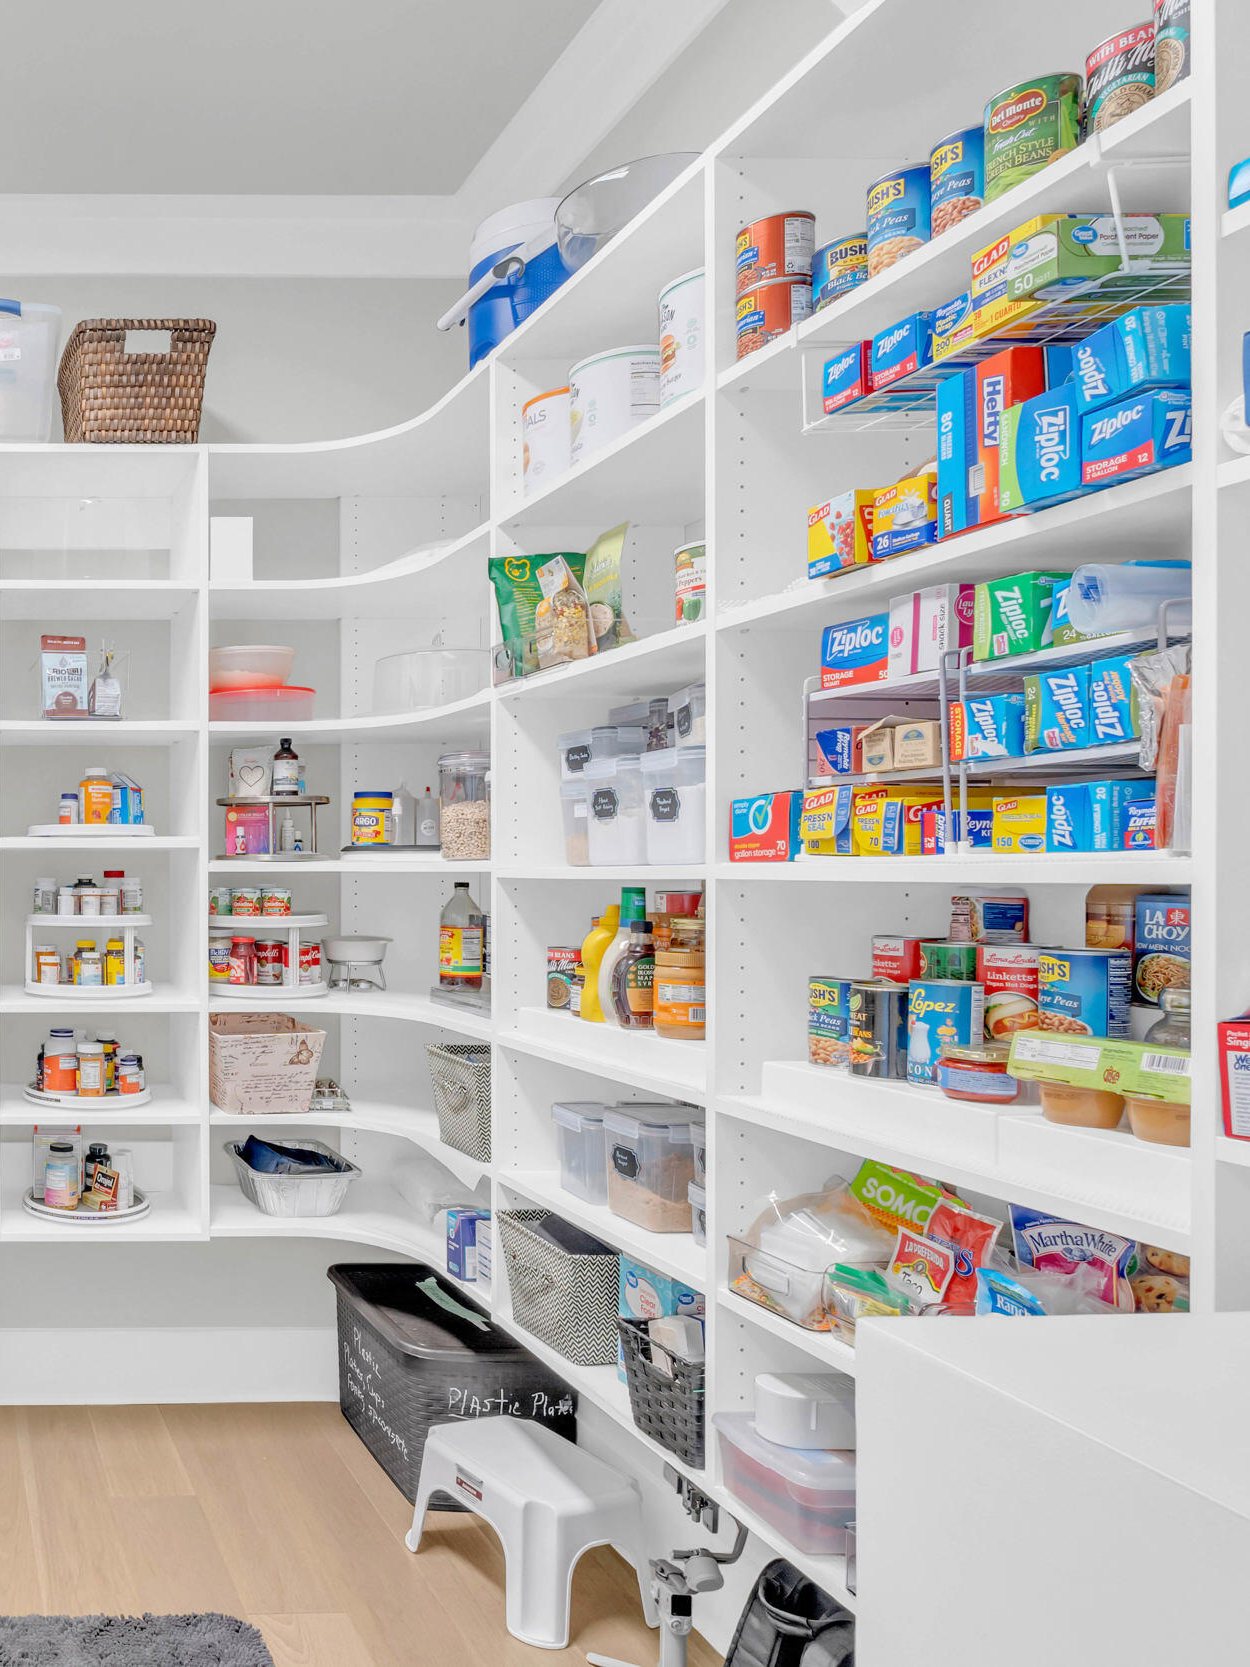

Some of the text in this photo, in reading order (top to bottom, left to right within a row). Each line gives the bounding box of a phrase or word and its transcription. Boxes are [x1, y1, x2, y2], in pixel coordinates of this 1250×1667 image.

[1089, 42, 1115, 68] WITH
[1098, 72, 1150, 102] VEGETARIAN
[991, 96, 1043, 127] Del Monte
[993, 127, 1038, 154] Fresh Cut
[1018, 136, 1055, 157] STYLE
[1015, 147, 1052, 167] BEANS
[947, 176, 973, 192] Peas
[883, 213, 909, 228] Peas
[1137, 232, 1159, 242] Paper
[830, 244, 868, 265] BUSH
[973, 237, 1009, 276] GLAD
[827, 273, 854, 291] Black
[1014, 272, 1035, 295] 50
[1124, 315, 1136, 332] 20
[877, 324, 911, 359] Ziploc
[935, 338, 951, 351] 200
[827, 353, 856, 385] Ziploc
[874, 365, 900, 384] STORAGE
[1077, 346, 1109, 402] Ziploc
[984, 380, 1001, 442] Hefty
[940, 411, 953, 434] 80
[1090, 404, 1144, 446] Ziploc
[1035, 410, 1066, 483] Ziploc
[1086, 452, 1149, 474] STORAGE 12
[1092, 465, 1118, 478] GALLON
[875, 488, 897, 507] GLAD
[1002, 491, 1011, 507] 90
[809, 505, 830, 526] GLAD
[944, 498, 953, 532] QUART
[877, 535, 889, 551] 26
[994, 586, 1030, 640] Ziploc
[832, 625, 884, 657] Ziploc
[1063, 628, 1077, 641] 24
[823, 669, 854, 682] STORAGE
[823, 680, 840, 688] QUART
[1026, 686, 1037, 701] 24
[1047, 673, 1086, 729] Ziploc
[1093, 681, 1126, 739] Ziploc
[954, 706, 963, 756] STORAGE
[1055, 711, 1077, 743] Marinade
[836, 731, 844, 753] Wrap
[842, 732, 850, 769] Reynolds
[805, 793, 833, 810] GLAD
[1096, 786, 1106, 801] 20
[855, 804, 877, 815] GLAD
[997, 801, 1018, 812] GLAD
[355, 816, 377, 826] ARGO
[803, 812, 833, 824] PRESS'N
[807, 822, 826, 832] SEAL
[1051, 794, 1073, 847] Ziploc
[776, 840, 786, 851] 70
[807, 840, 820, 849] 100
[869, 837, 879, 847] 70
[996, 836, 1013, 847] 150
[734, 848, 776, 860] gallon storage
[1144, 909, 1165, 926] LA
[1169, 909, 1189, 926] 東
[1144, 924, 1190, 941] CHOY
[554, 951, 575, 959] BEANS
[1149, 943, 1168, 951] MEIN
[987, 971, 1034, 982] Linketts
[1053, 995, 1080, 1009] Peas
[820, 1014, 841, 1027] Peas
[1029, 1230, 1117, 1258] Martha White
[905, 1240, 914, 1253] LA
[913, 1242, 944, 1271] PREFERIDA
[639, 1294, 656, 1309] Clear
[531, 1391, 574, 1417] Plates
